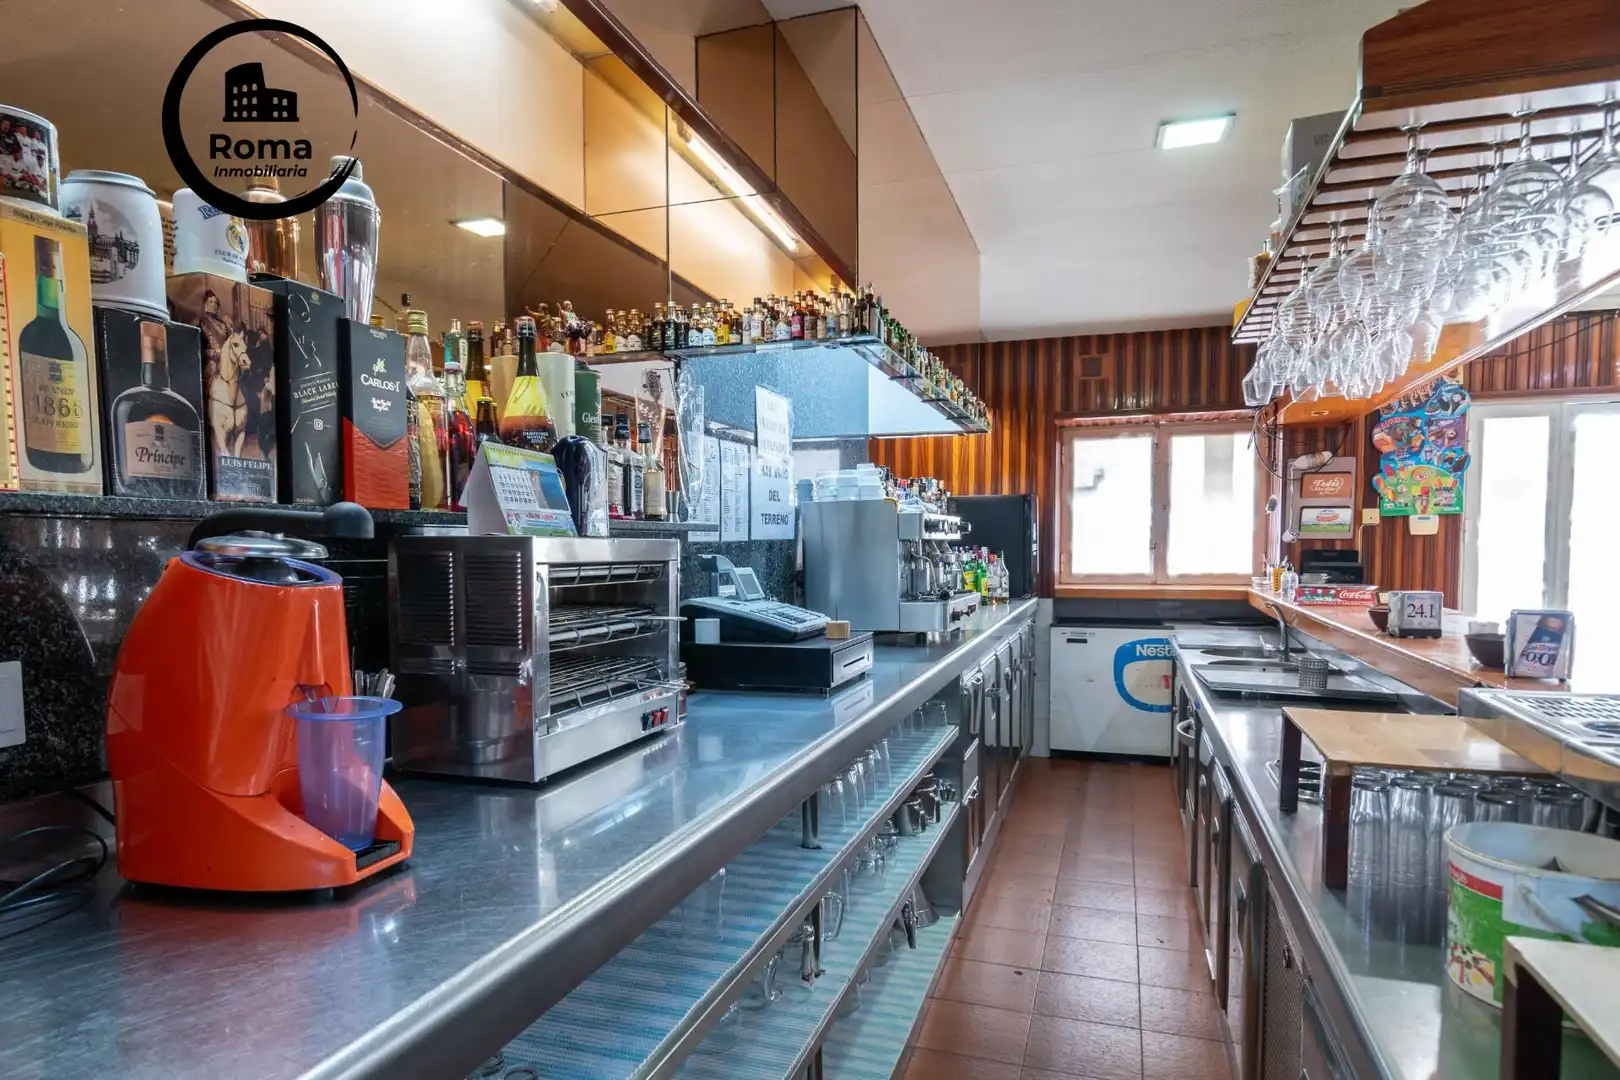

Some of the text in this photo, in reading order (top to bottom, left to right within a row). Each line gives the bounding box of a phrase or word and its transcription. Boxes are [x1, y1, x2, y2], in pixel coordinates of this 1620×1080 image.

[292, 387, 318, 399] BLACK
[221, 458, 272, 471] LUIS FELIPE
[768, 490, 781, 503] DEL
[761, 513, 789, 525] TERRENO
[1407, 603, 1434, 618] 24.1
[1135, 644, 1176, 657] Nest
